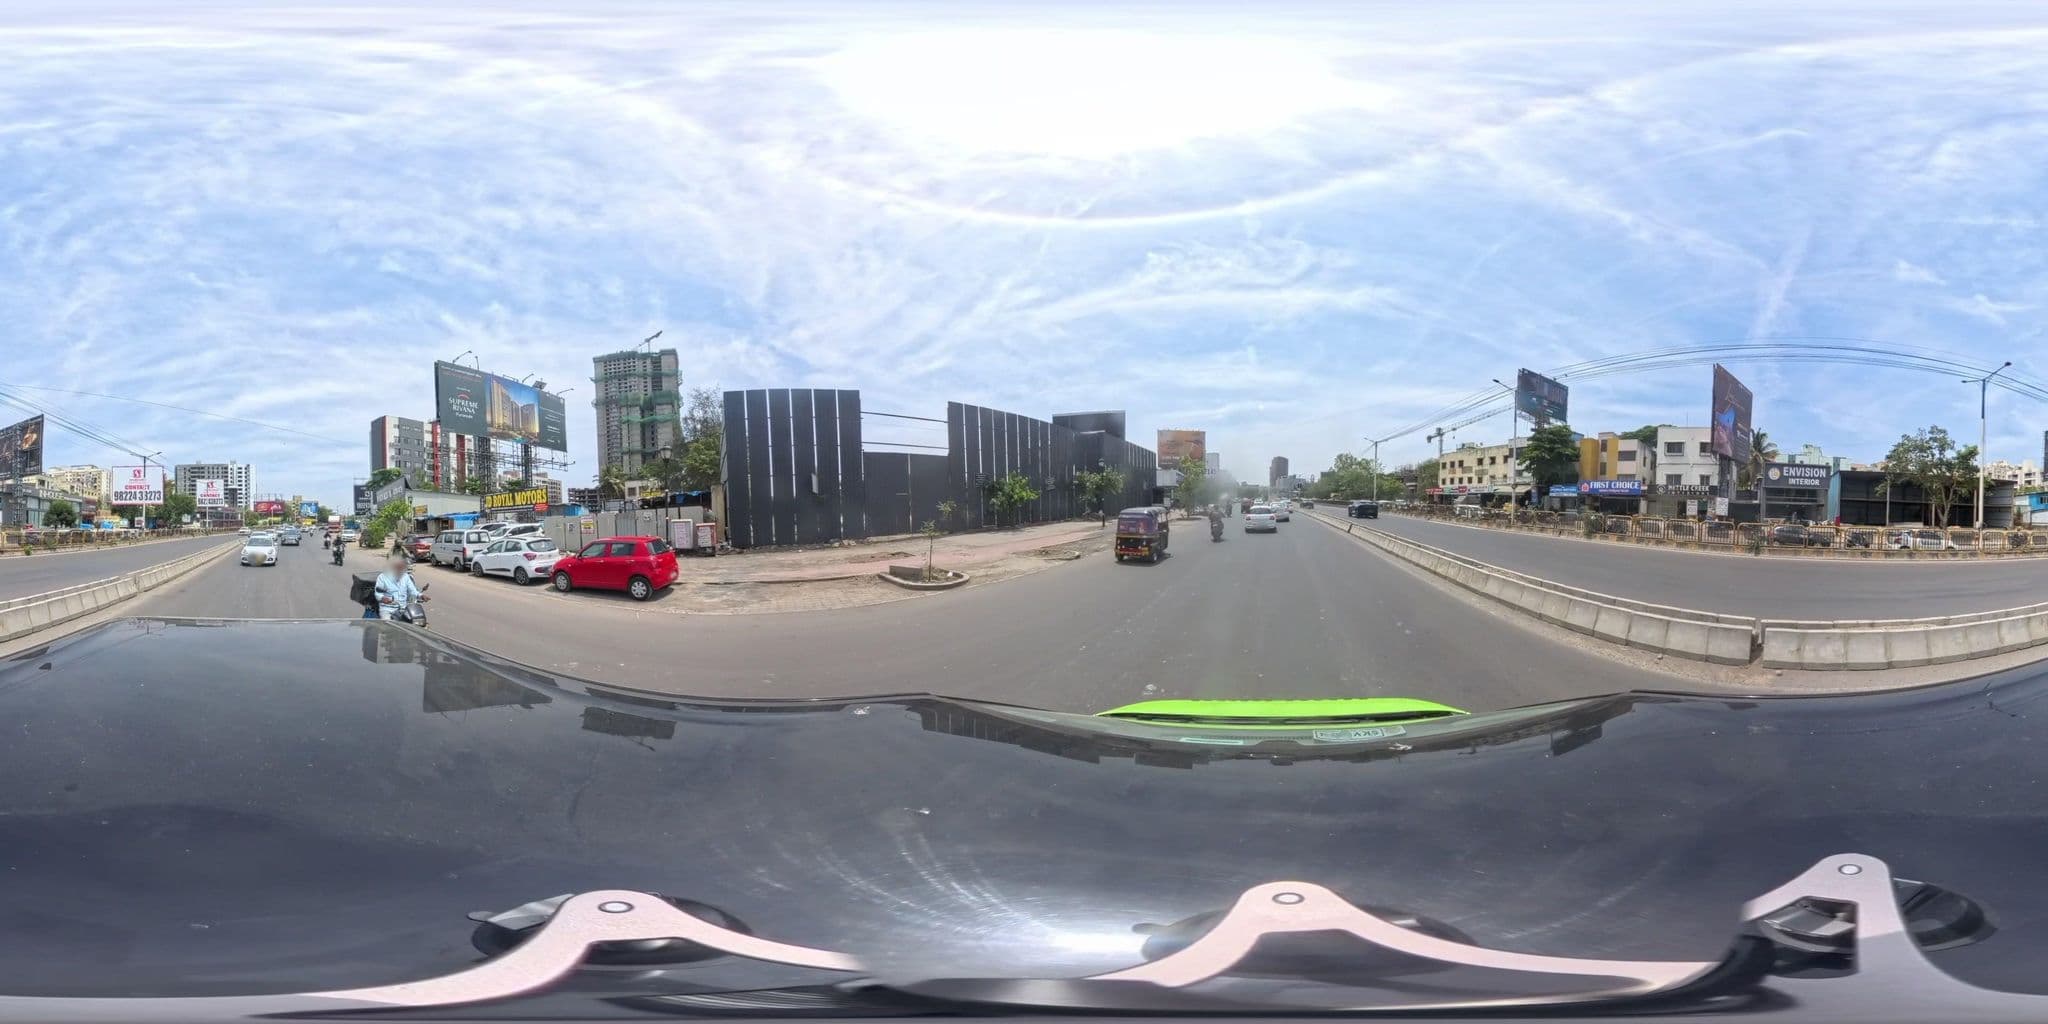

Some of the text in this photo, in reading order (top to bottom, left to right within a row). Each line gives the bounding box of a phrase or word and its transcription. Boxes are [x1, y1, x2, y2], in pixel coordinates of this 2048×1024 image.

[448, 397, 478, 409] SUPREME
[1783, 467, 1826, 478] ENVISION
[1590, 481, 1640, 489] FIRST CHOICE
[1788, 478, 1820, 486] INTERIOR
[493, 493, 514, 508] ROYAL
[514, 489, 547, 505] MOTORS
